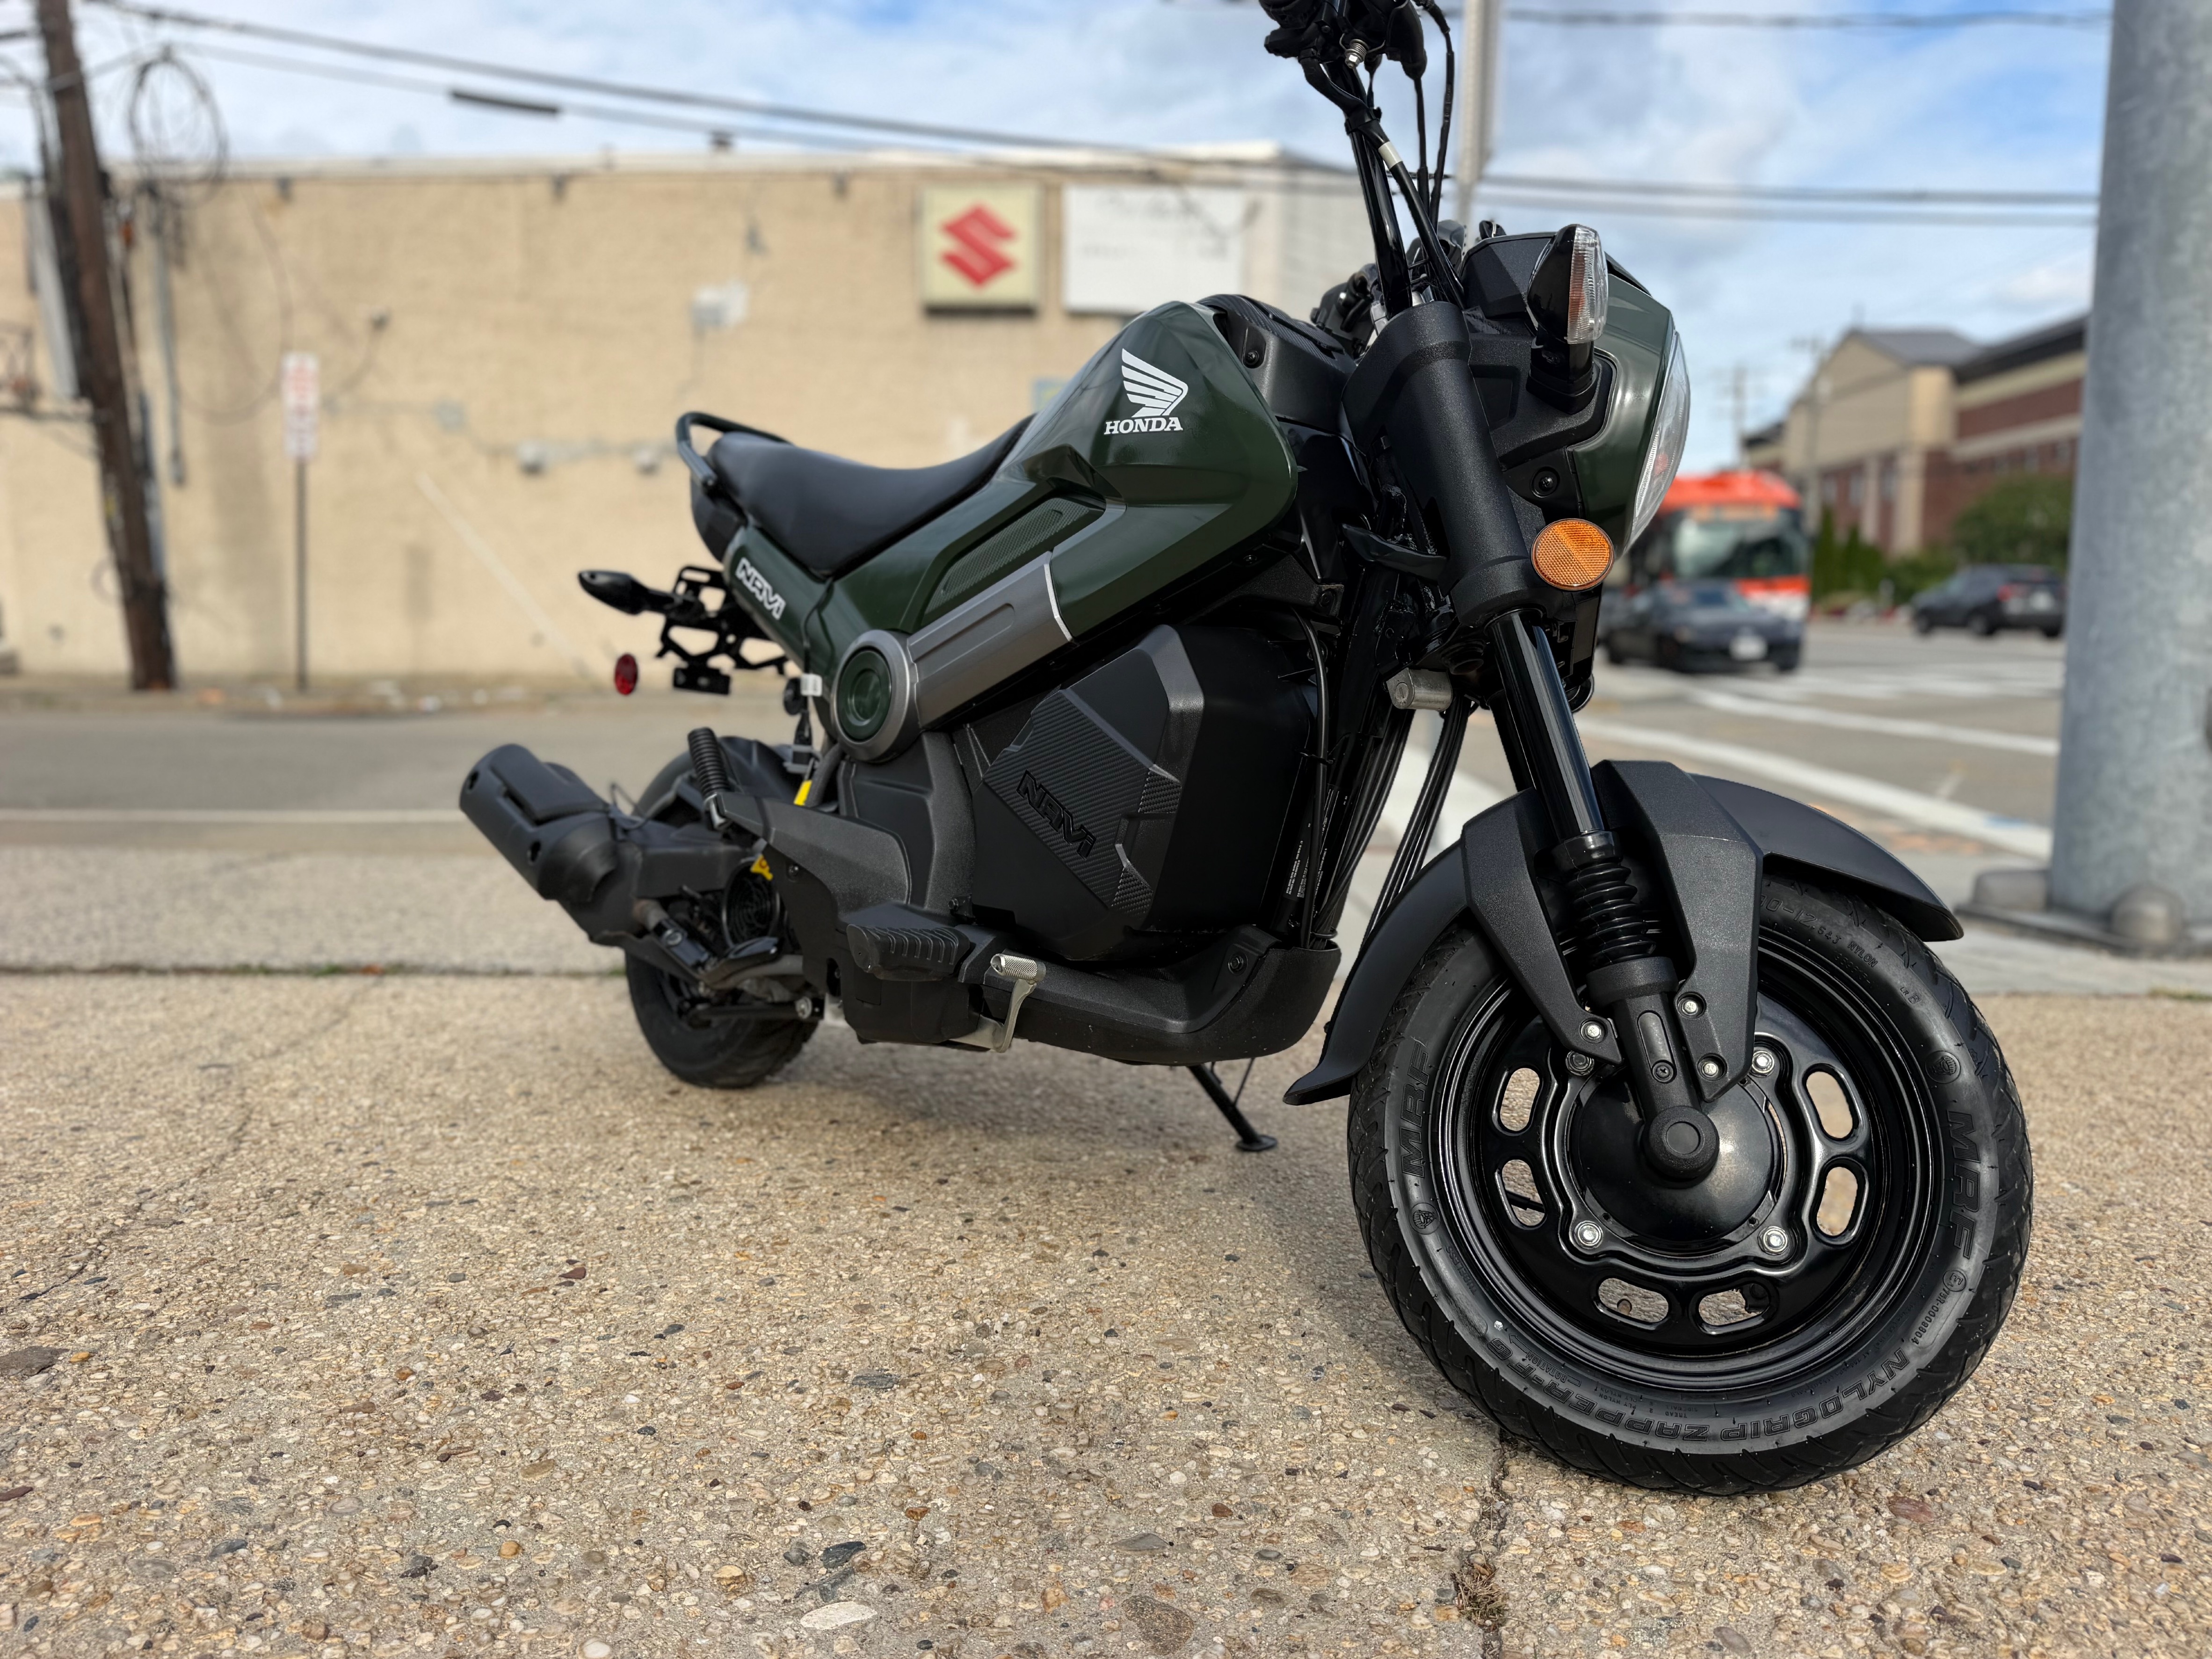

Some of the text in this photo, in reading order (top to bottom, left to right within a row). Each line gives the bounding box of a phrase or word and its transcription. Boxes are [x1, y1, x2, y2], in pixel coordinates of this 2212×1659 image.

[1104, 417, 1183, 435] HONDA
[735, 557, 786, 620] NAVI
[1016, 770, 1096, 860] NAVI
[1847, 941, 1878, 968] NYLON
[1399, 1041, 1429, 1179] MRF
[1946, 1110, 1981, 1259] MRF
[1445, 1245, 1477, 1295] TUBELESS
[1487, 1338, 1910, 1441] NYLOGRIP ZAPPER-FG
[1525, 1351, 1568, 1383] ROTATION
[1598, 1393, 1621, 1405] NYLON
